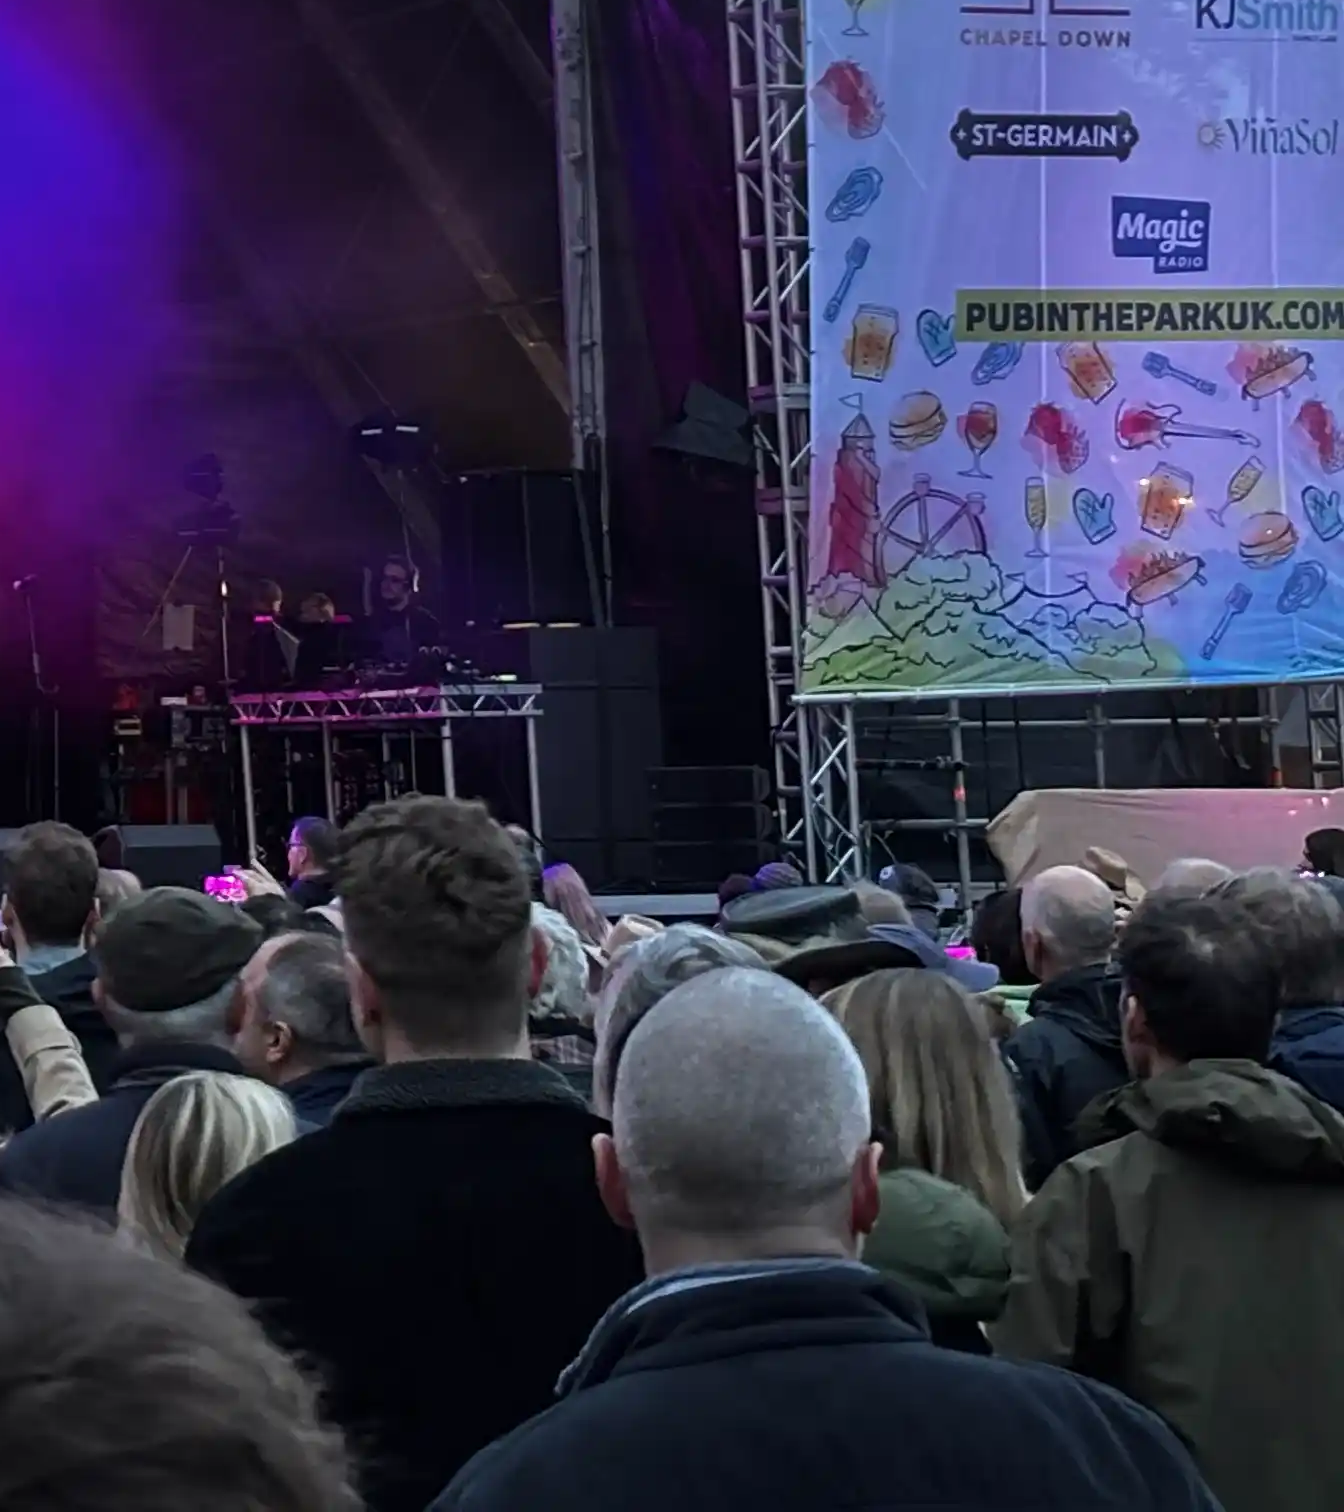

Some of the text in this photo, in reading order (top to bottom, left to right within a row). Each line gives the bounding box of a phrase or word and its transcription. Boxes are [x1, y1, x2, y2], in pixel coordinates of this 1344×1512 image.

[960, 28, 1131, 48] CHAPEL DOWN
[1117, 209, 1204, 253] Magic
[1159, 256, 1203, 267] RADIO
[966, 302, 1344, 331] PUBINTHEPARKUK.COM
